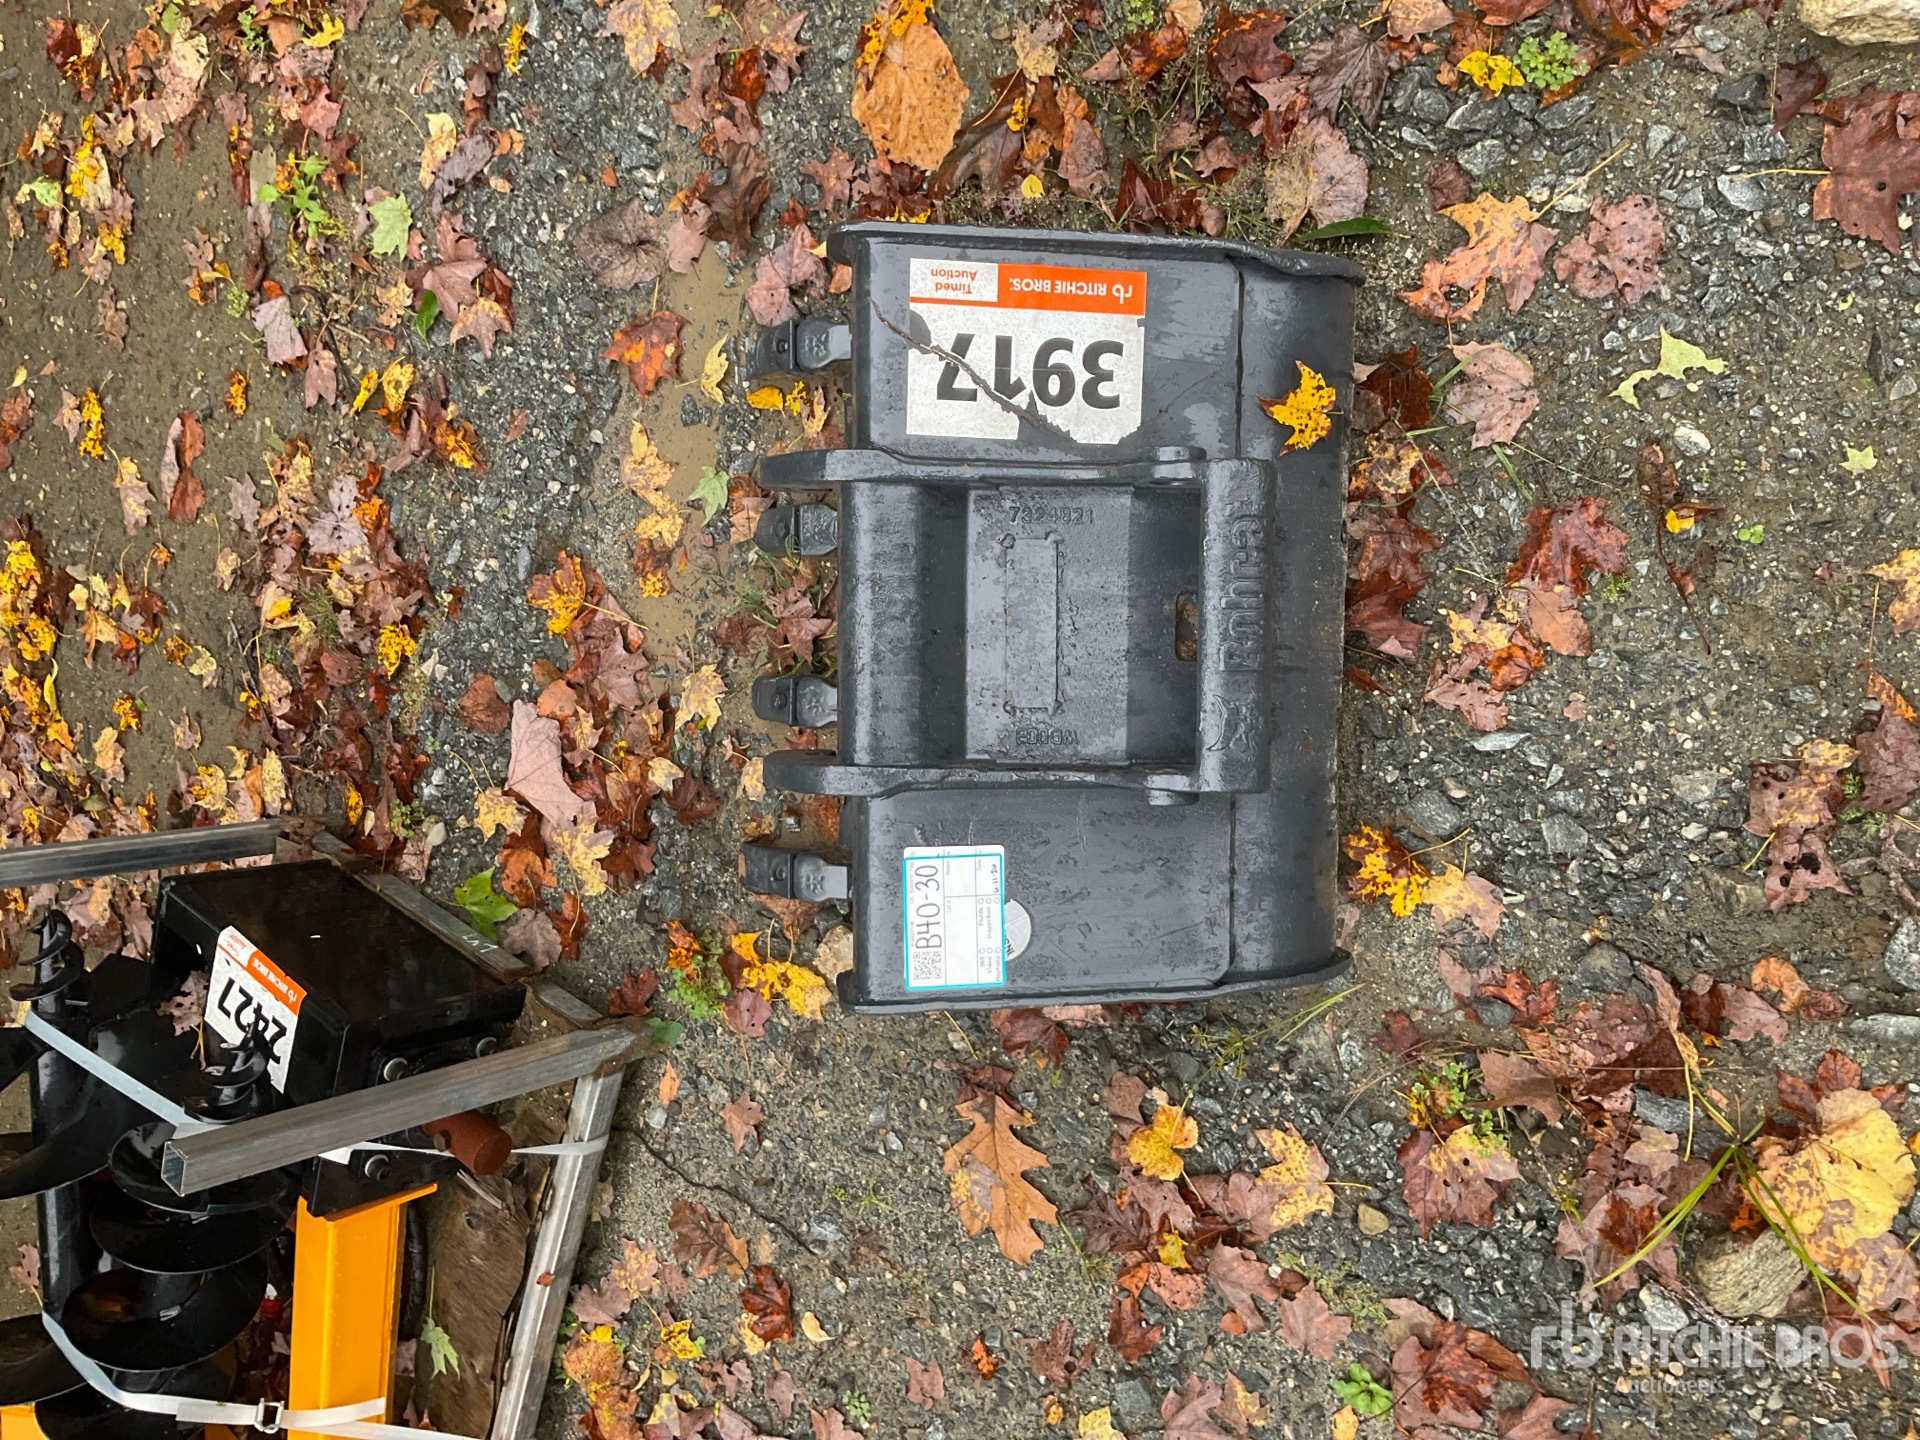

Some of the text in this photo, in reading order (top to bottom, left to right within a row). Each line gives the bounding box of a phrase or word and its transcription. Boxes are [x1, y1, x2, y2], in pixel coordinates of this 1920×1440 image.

[931, 268, 978, 280] Auction
[935, 282, 972, 294] Timed
[1055, 280, 1106, 296] RITCHIE
[937, 333, 1124, 409] 3917
[914, 865, 943, 949] B40-30
[217, 976, 288, 1065] 2427
